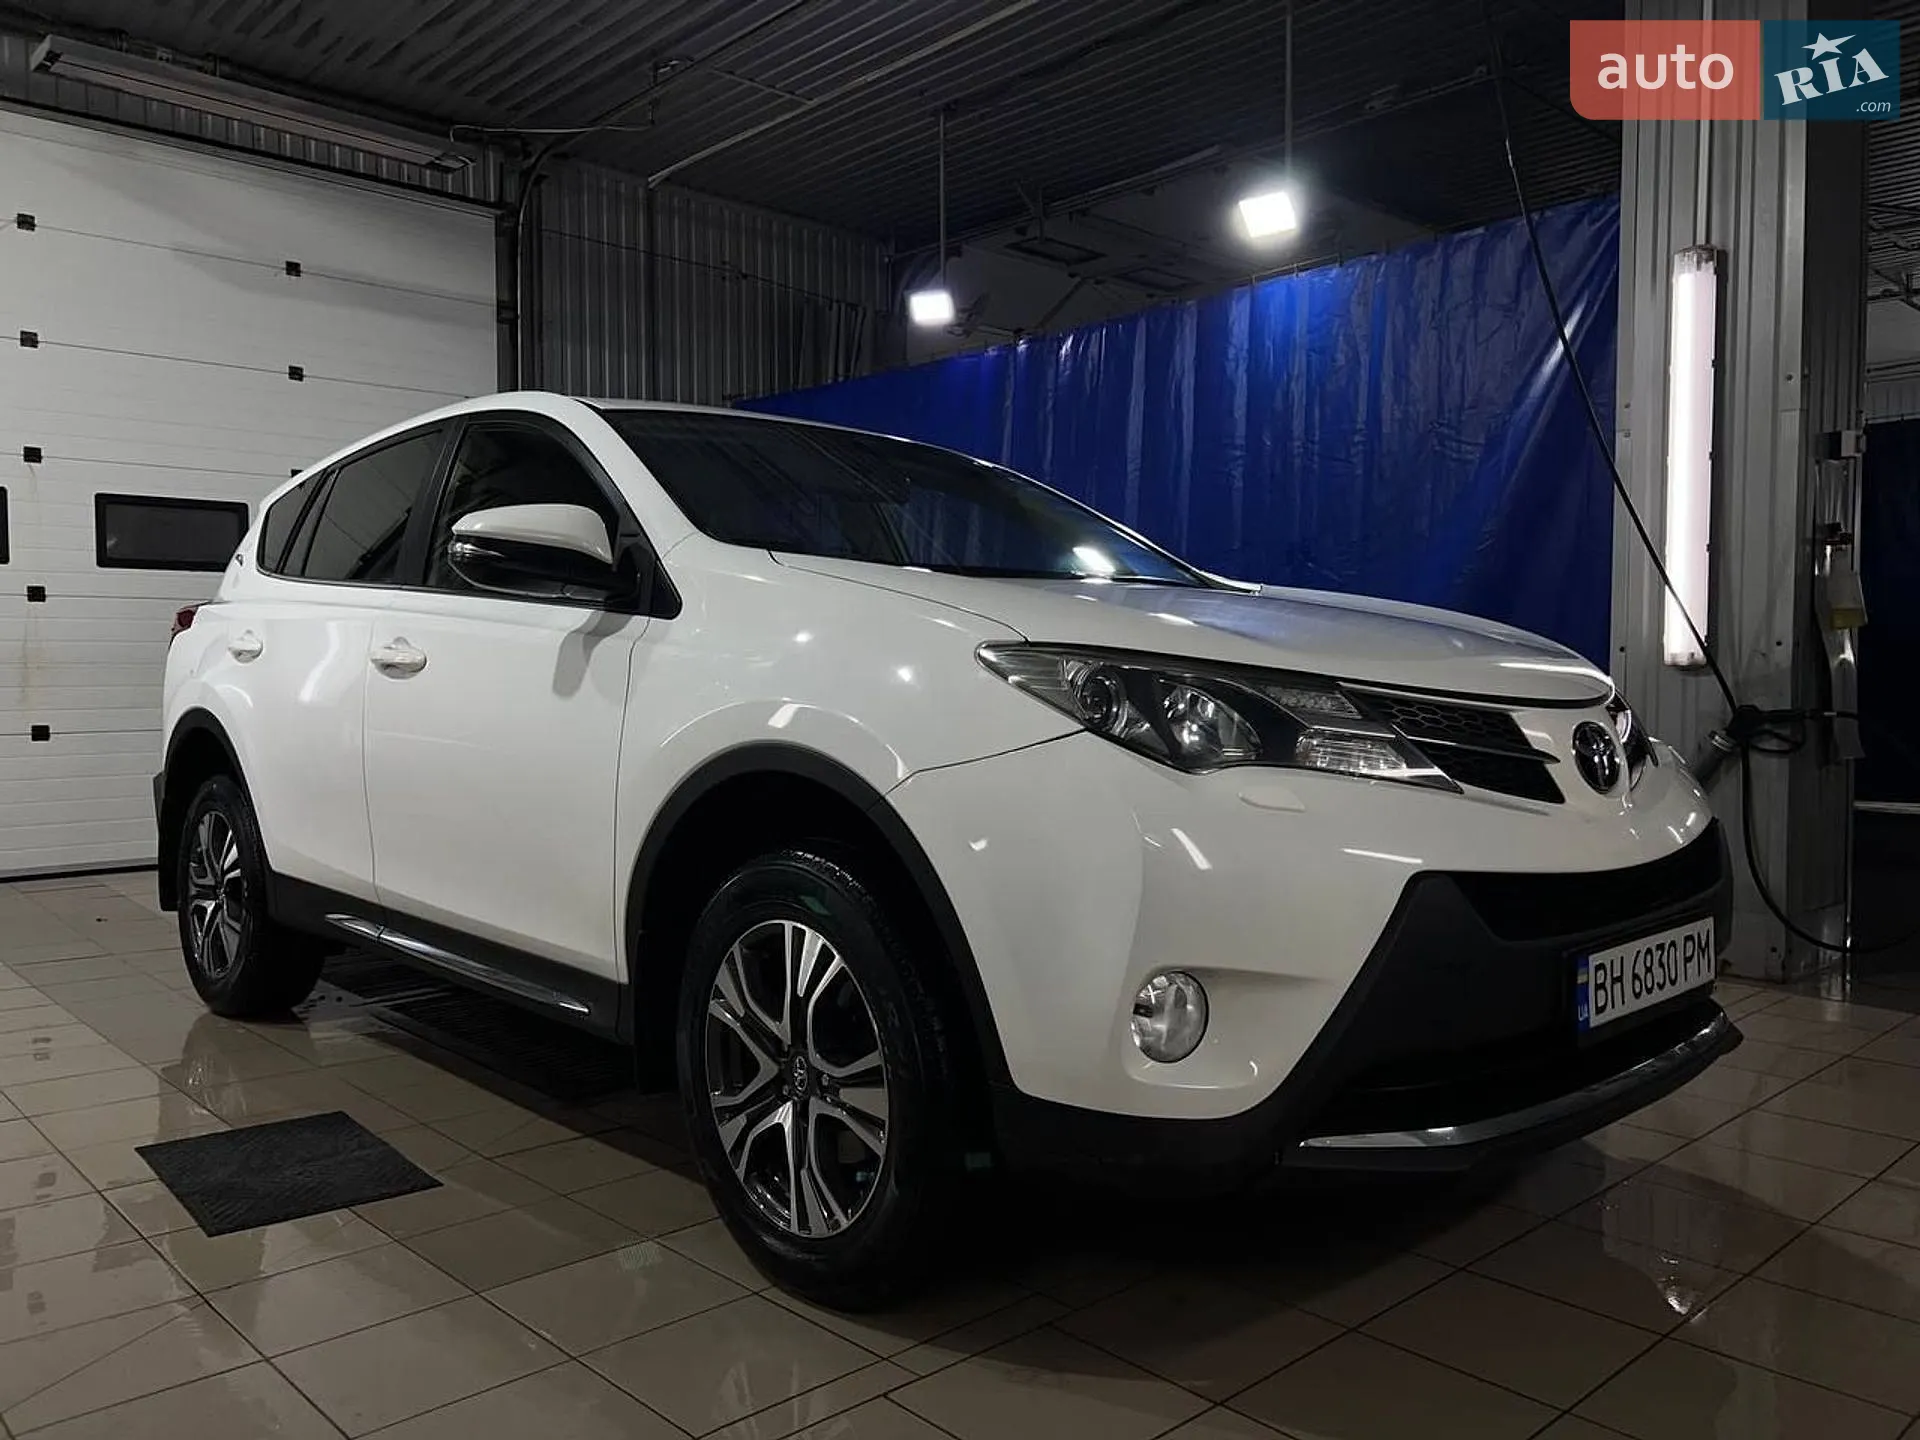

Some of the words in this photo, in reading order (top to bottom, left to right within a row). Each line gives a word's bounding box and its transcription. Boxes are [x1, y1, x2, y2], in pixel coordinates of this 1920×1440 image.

[1594, 956, 1625, 1016] BH
[1631, 939, 1678, 999] 6830
[1683, 928, 1711, 982] PM
